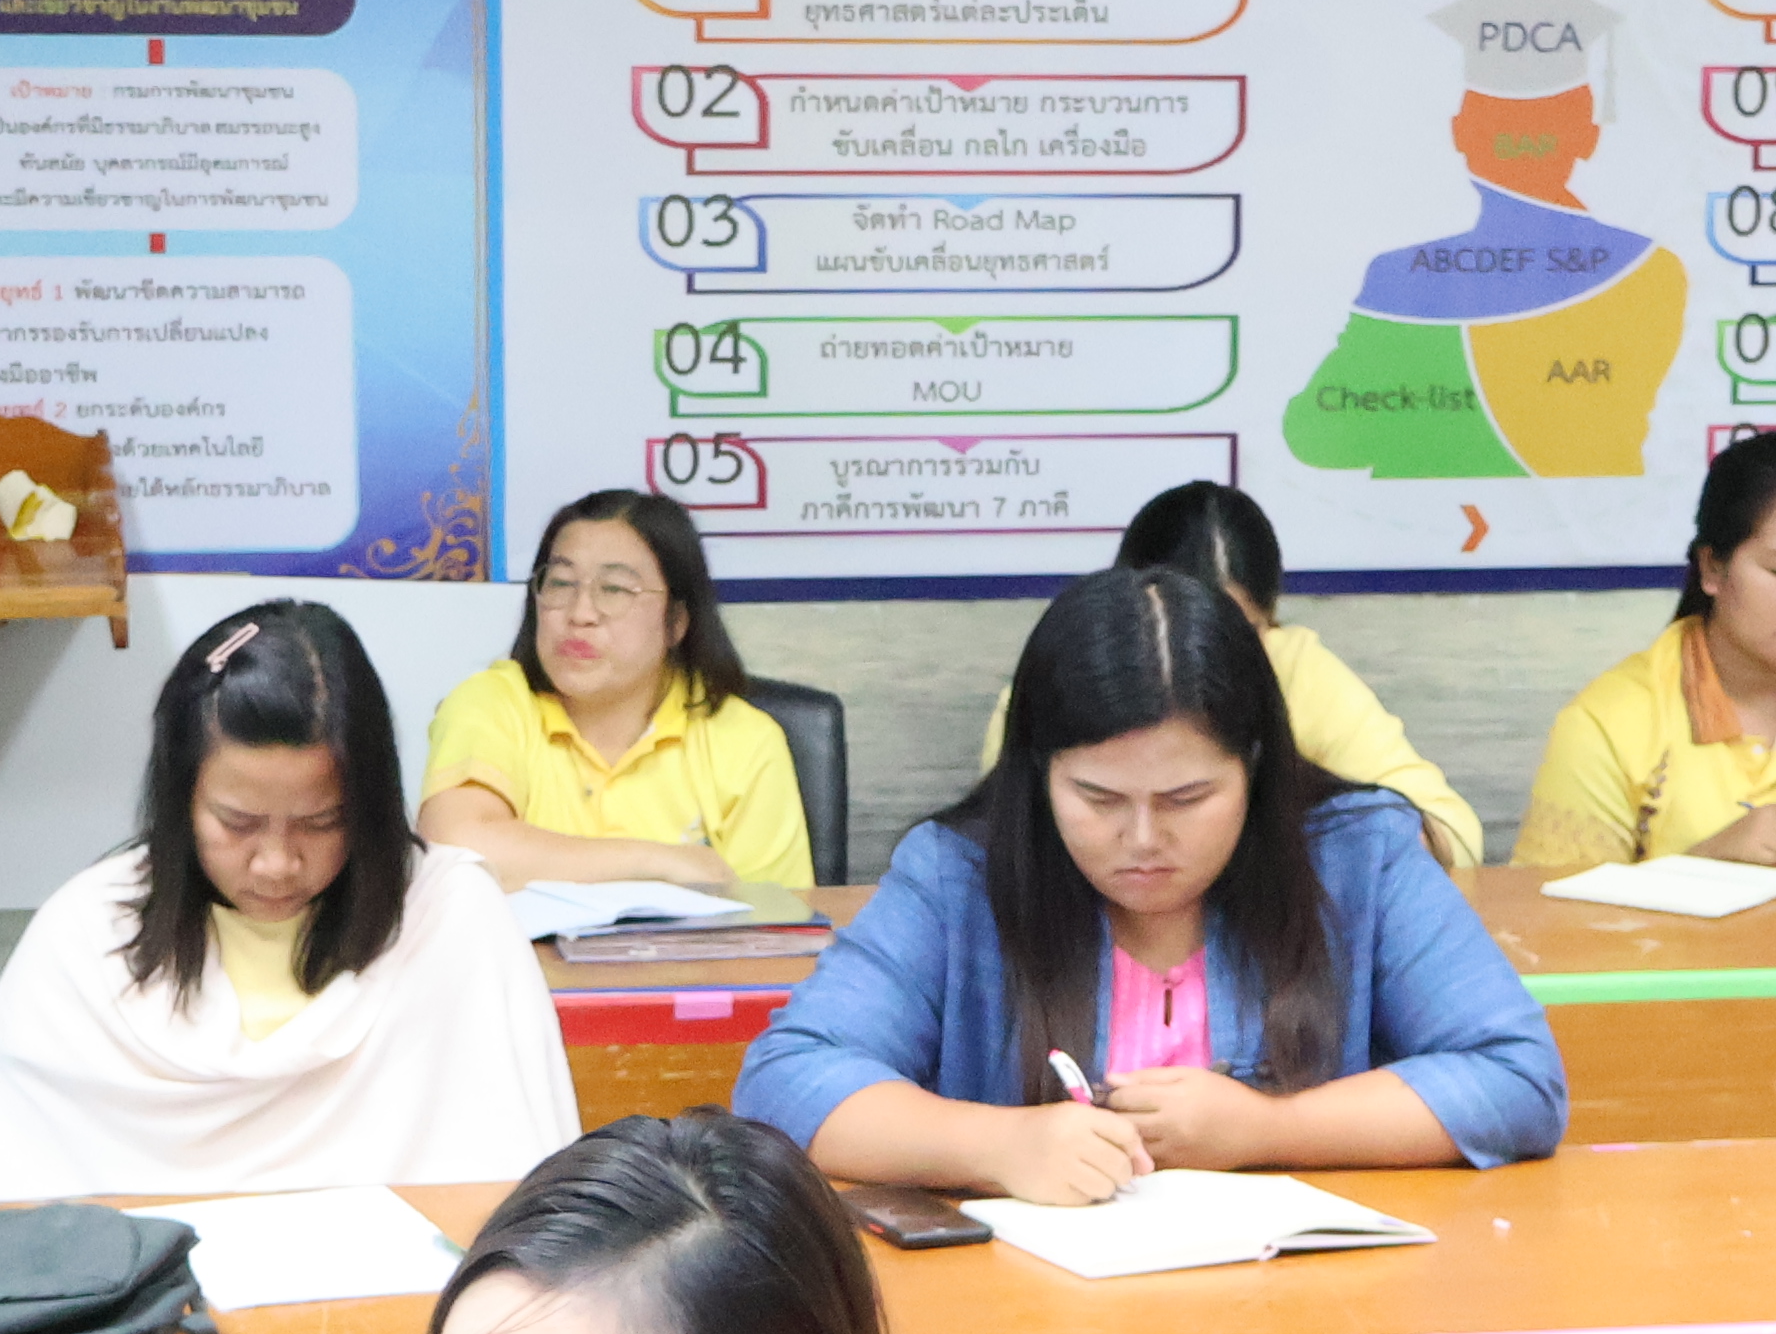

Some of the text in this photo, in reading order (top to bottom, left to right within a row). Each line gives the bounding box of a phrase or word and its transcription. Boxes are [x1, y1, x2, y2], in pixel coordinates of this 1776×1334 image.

[1479, 21, 1583, 53] PDCA
[656, 63, 741, 119] 02
[790, 83, 1189, 116] กำหนดค่าเป้าหมาย กระบวนการ
[832, 126, 1147, 159] ขับเคลื่อน กลไก เครื่องมือ
[656, 193, 740, 248] 03
[851, 205, 1076, 239] จัดทำ Road Map
[815, 241, 1110, 280] แผนขับเคลื่อนยุทธศาสตร์
[664, 320, 748, 377] 04
[1547, 358, 1612, 384] AAR
[912, 381, 982, 404] MOU
[661, 431, 745, 486] 05
[993, 497, 1006, 519] 7
